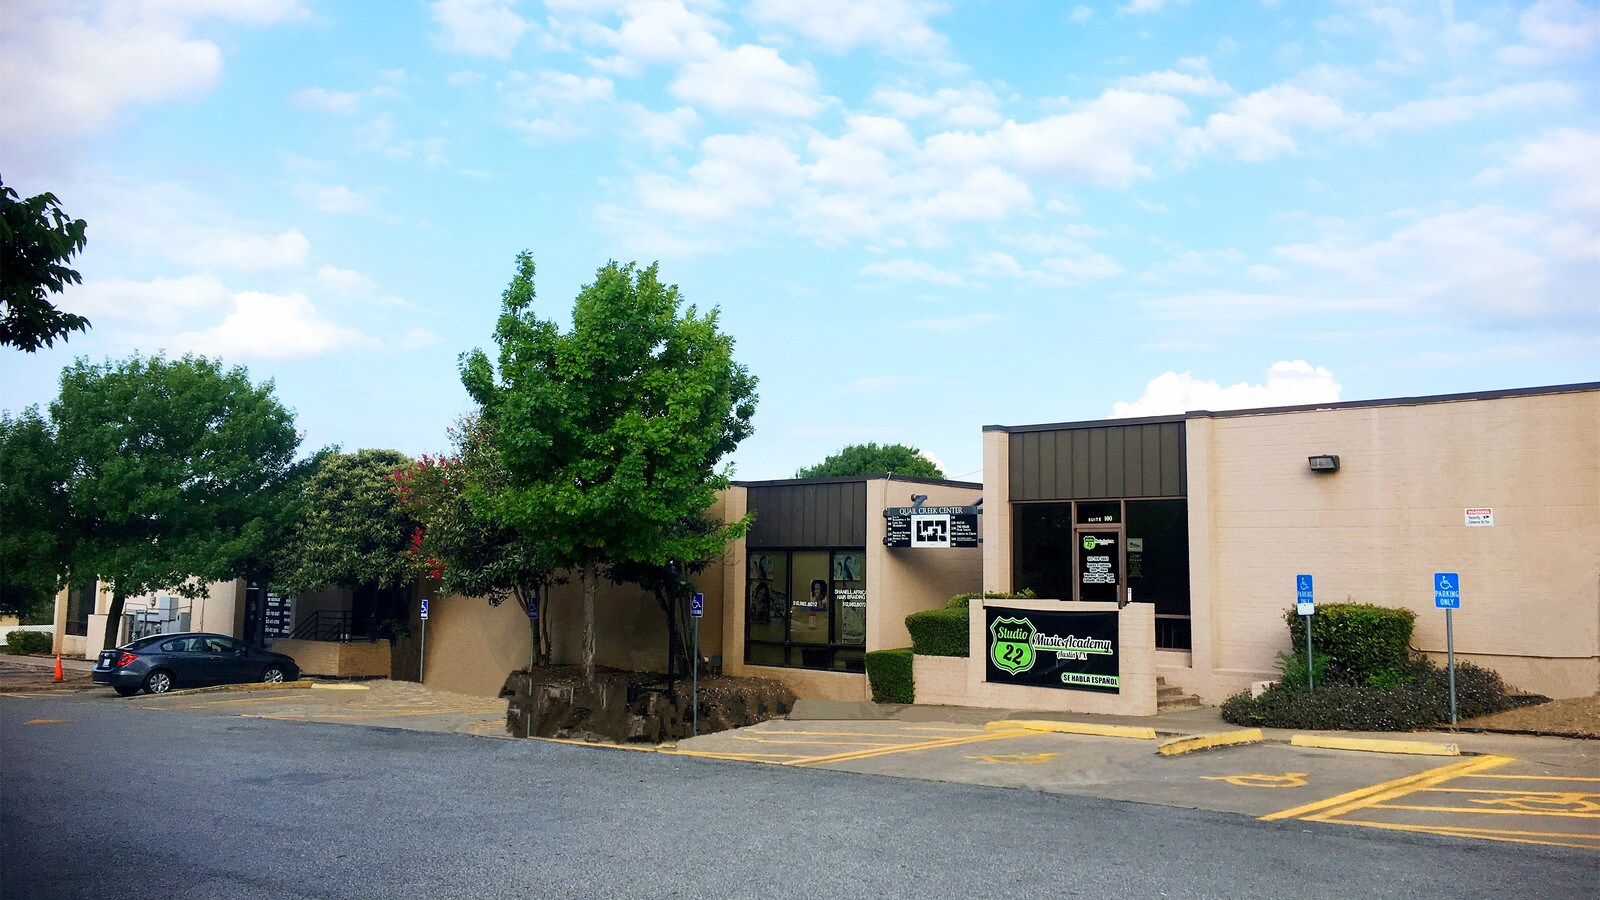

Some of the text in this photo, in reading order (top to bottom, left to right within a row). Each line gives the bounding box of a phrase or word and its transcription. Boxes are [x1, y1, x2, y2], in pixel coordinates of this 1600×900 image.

[900, 508, 917, 516] QUAIL
[1435, 590, 1459, 598] PARKING
[1440, 598, 1454, 606] ONLY
[998, 626, 1029, 640] Studio
[1034, 633, 1111, 653] Music Academy
[1003, 644, 1024, 665] 22
[1071, 674, 1091, 683] HABLA
[1092, 676, 1118, 686] ESPAÑOL
